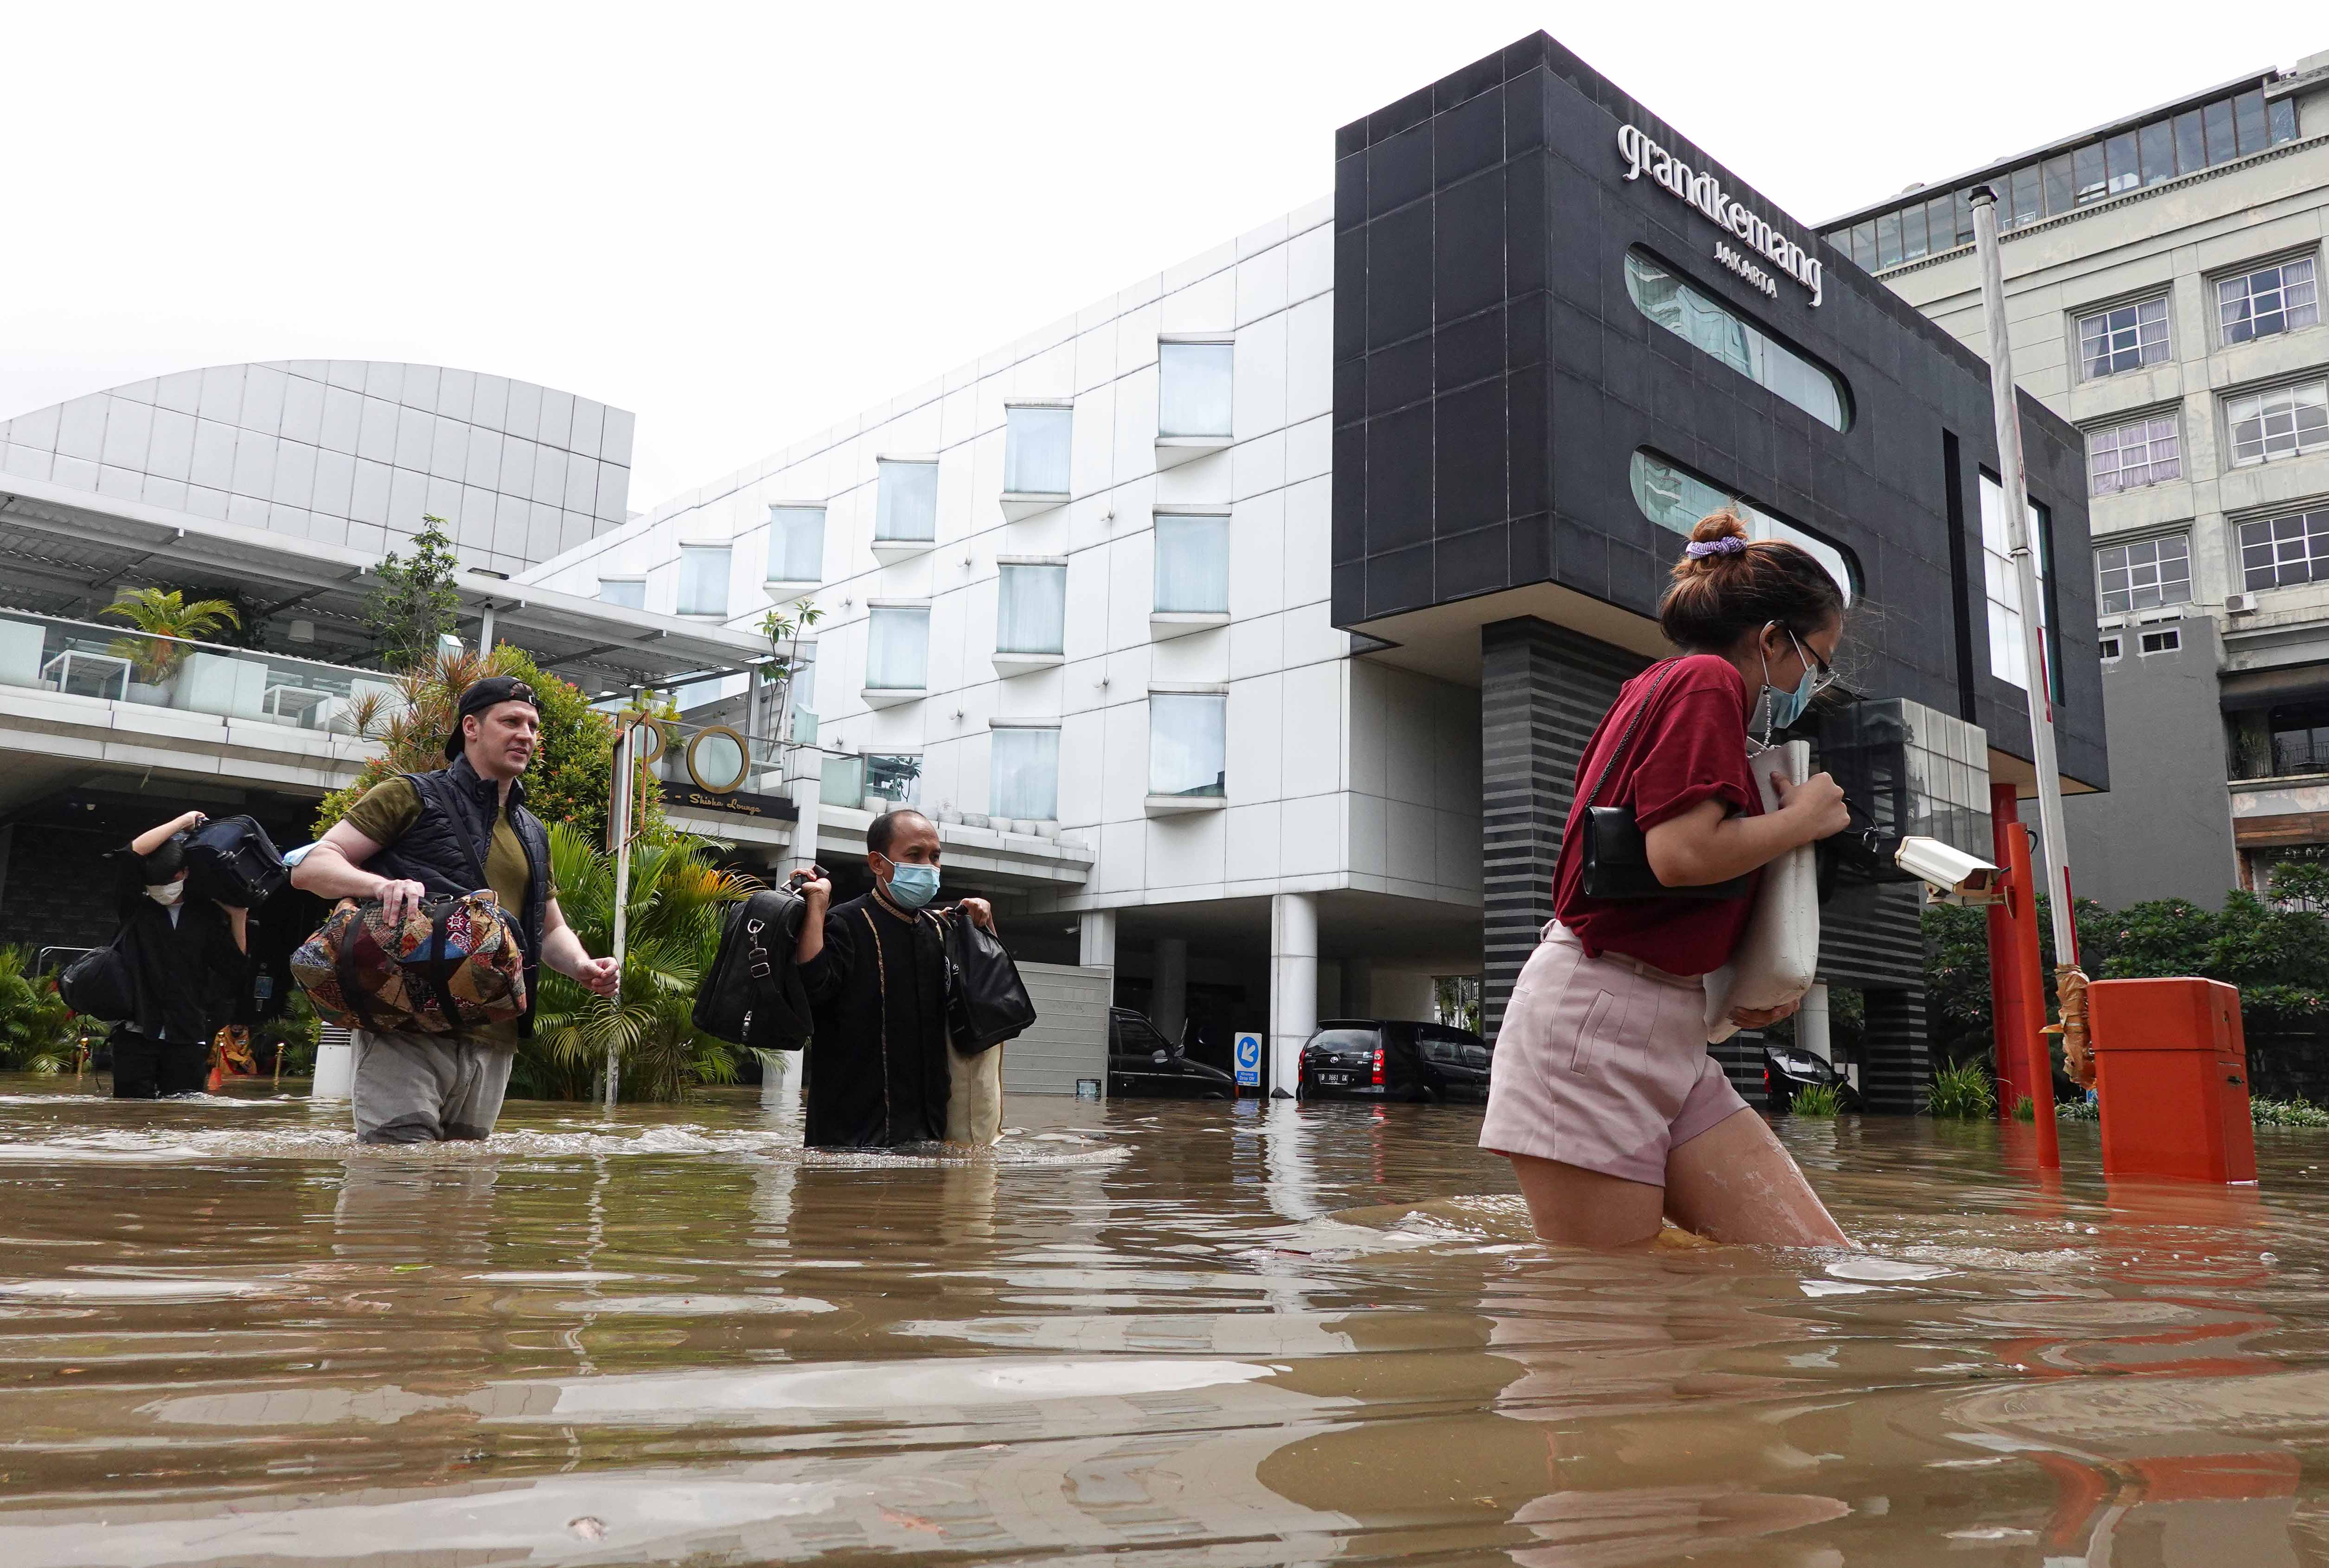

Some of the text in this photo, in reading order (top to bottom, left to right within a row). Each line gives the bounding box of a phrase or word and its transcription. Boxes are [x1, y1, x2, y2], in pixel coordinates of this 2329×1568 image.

[1618, 124, 1823, 307] grandkemang
[1714, 241, 1778, 298] JAKARTA
[727, 799, 761, 815] Lounge
